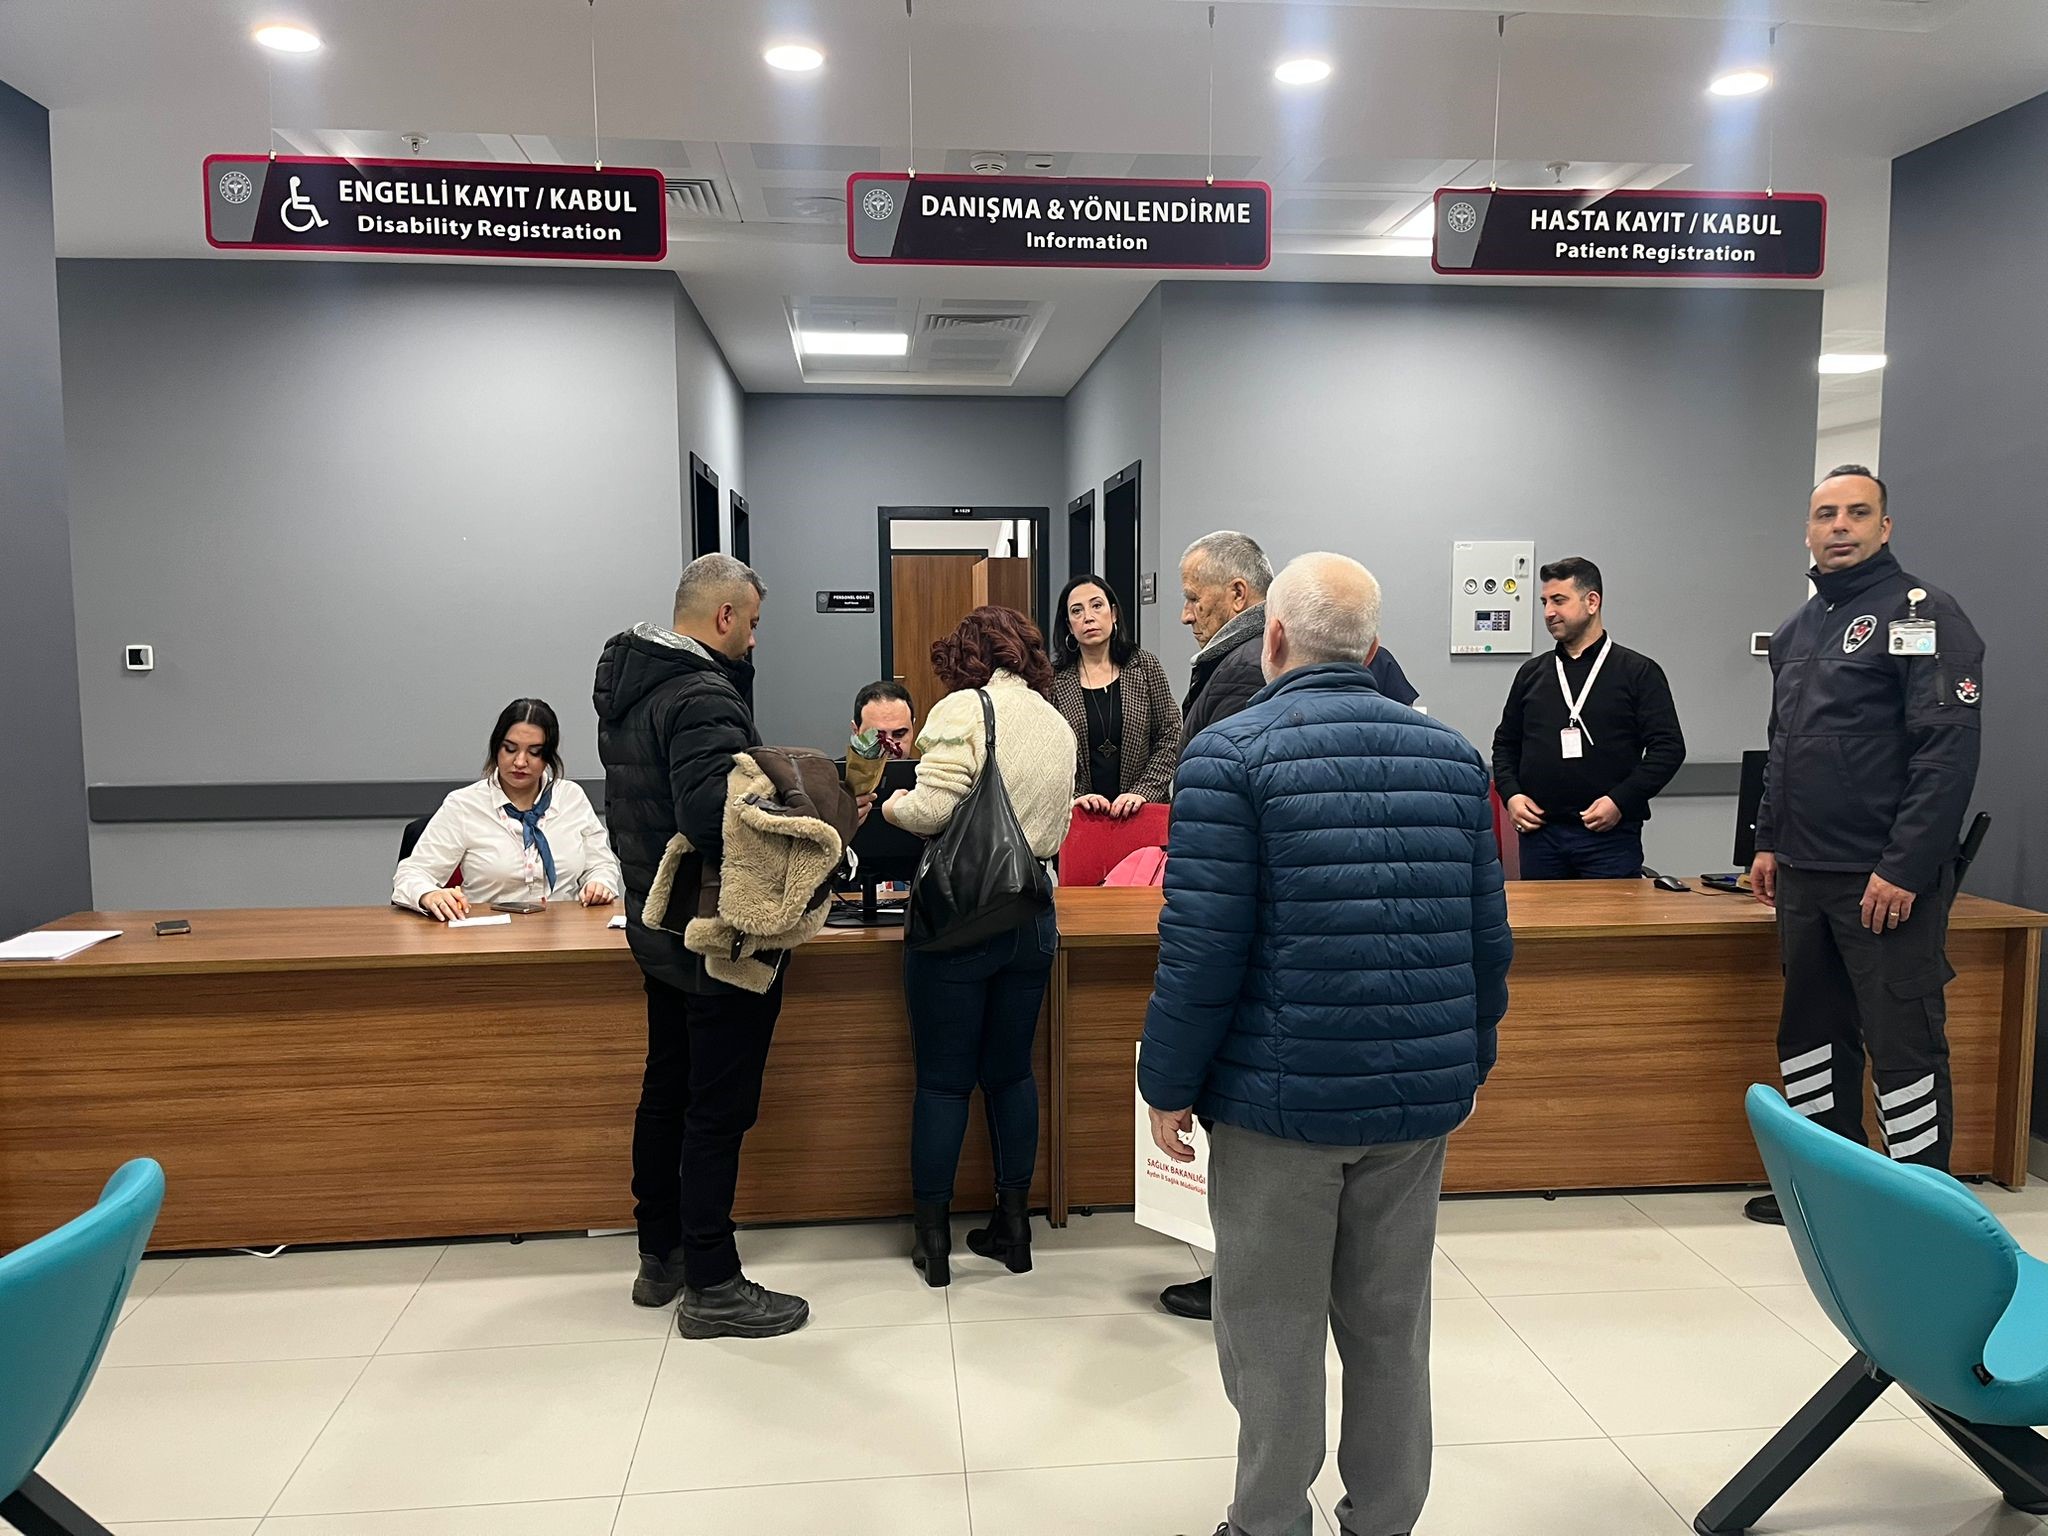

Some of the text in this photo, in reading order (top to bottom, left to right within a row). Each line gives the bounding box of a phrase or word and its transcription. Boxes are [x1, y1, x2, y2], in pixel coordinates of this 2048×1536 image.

[339, 178, 637, 213] ENGELLİ KAYIT / KABUL
[922, 195, 1042, 224] DANIŞMA
[1048, 198, 1065, 220] &
[1069, 196, 1251, 224] YÖNLENDİRME
[1530, 208, 1782, 235] HASTA KAYIT / KABUL
[357, 215, 621, 241] Disability Registration
[1026, 231, 1148, 250] Information
[1555, 242, 1756, 263] Patient Registration
[1147, 1159, 1207, 1184] SAĞLIK BAKANLIĞI
